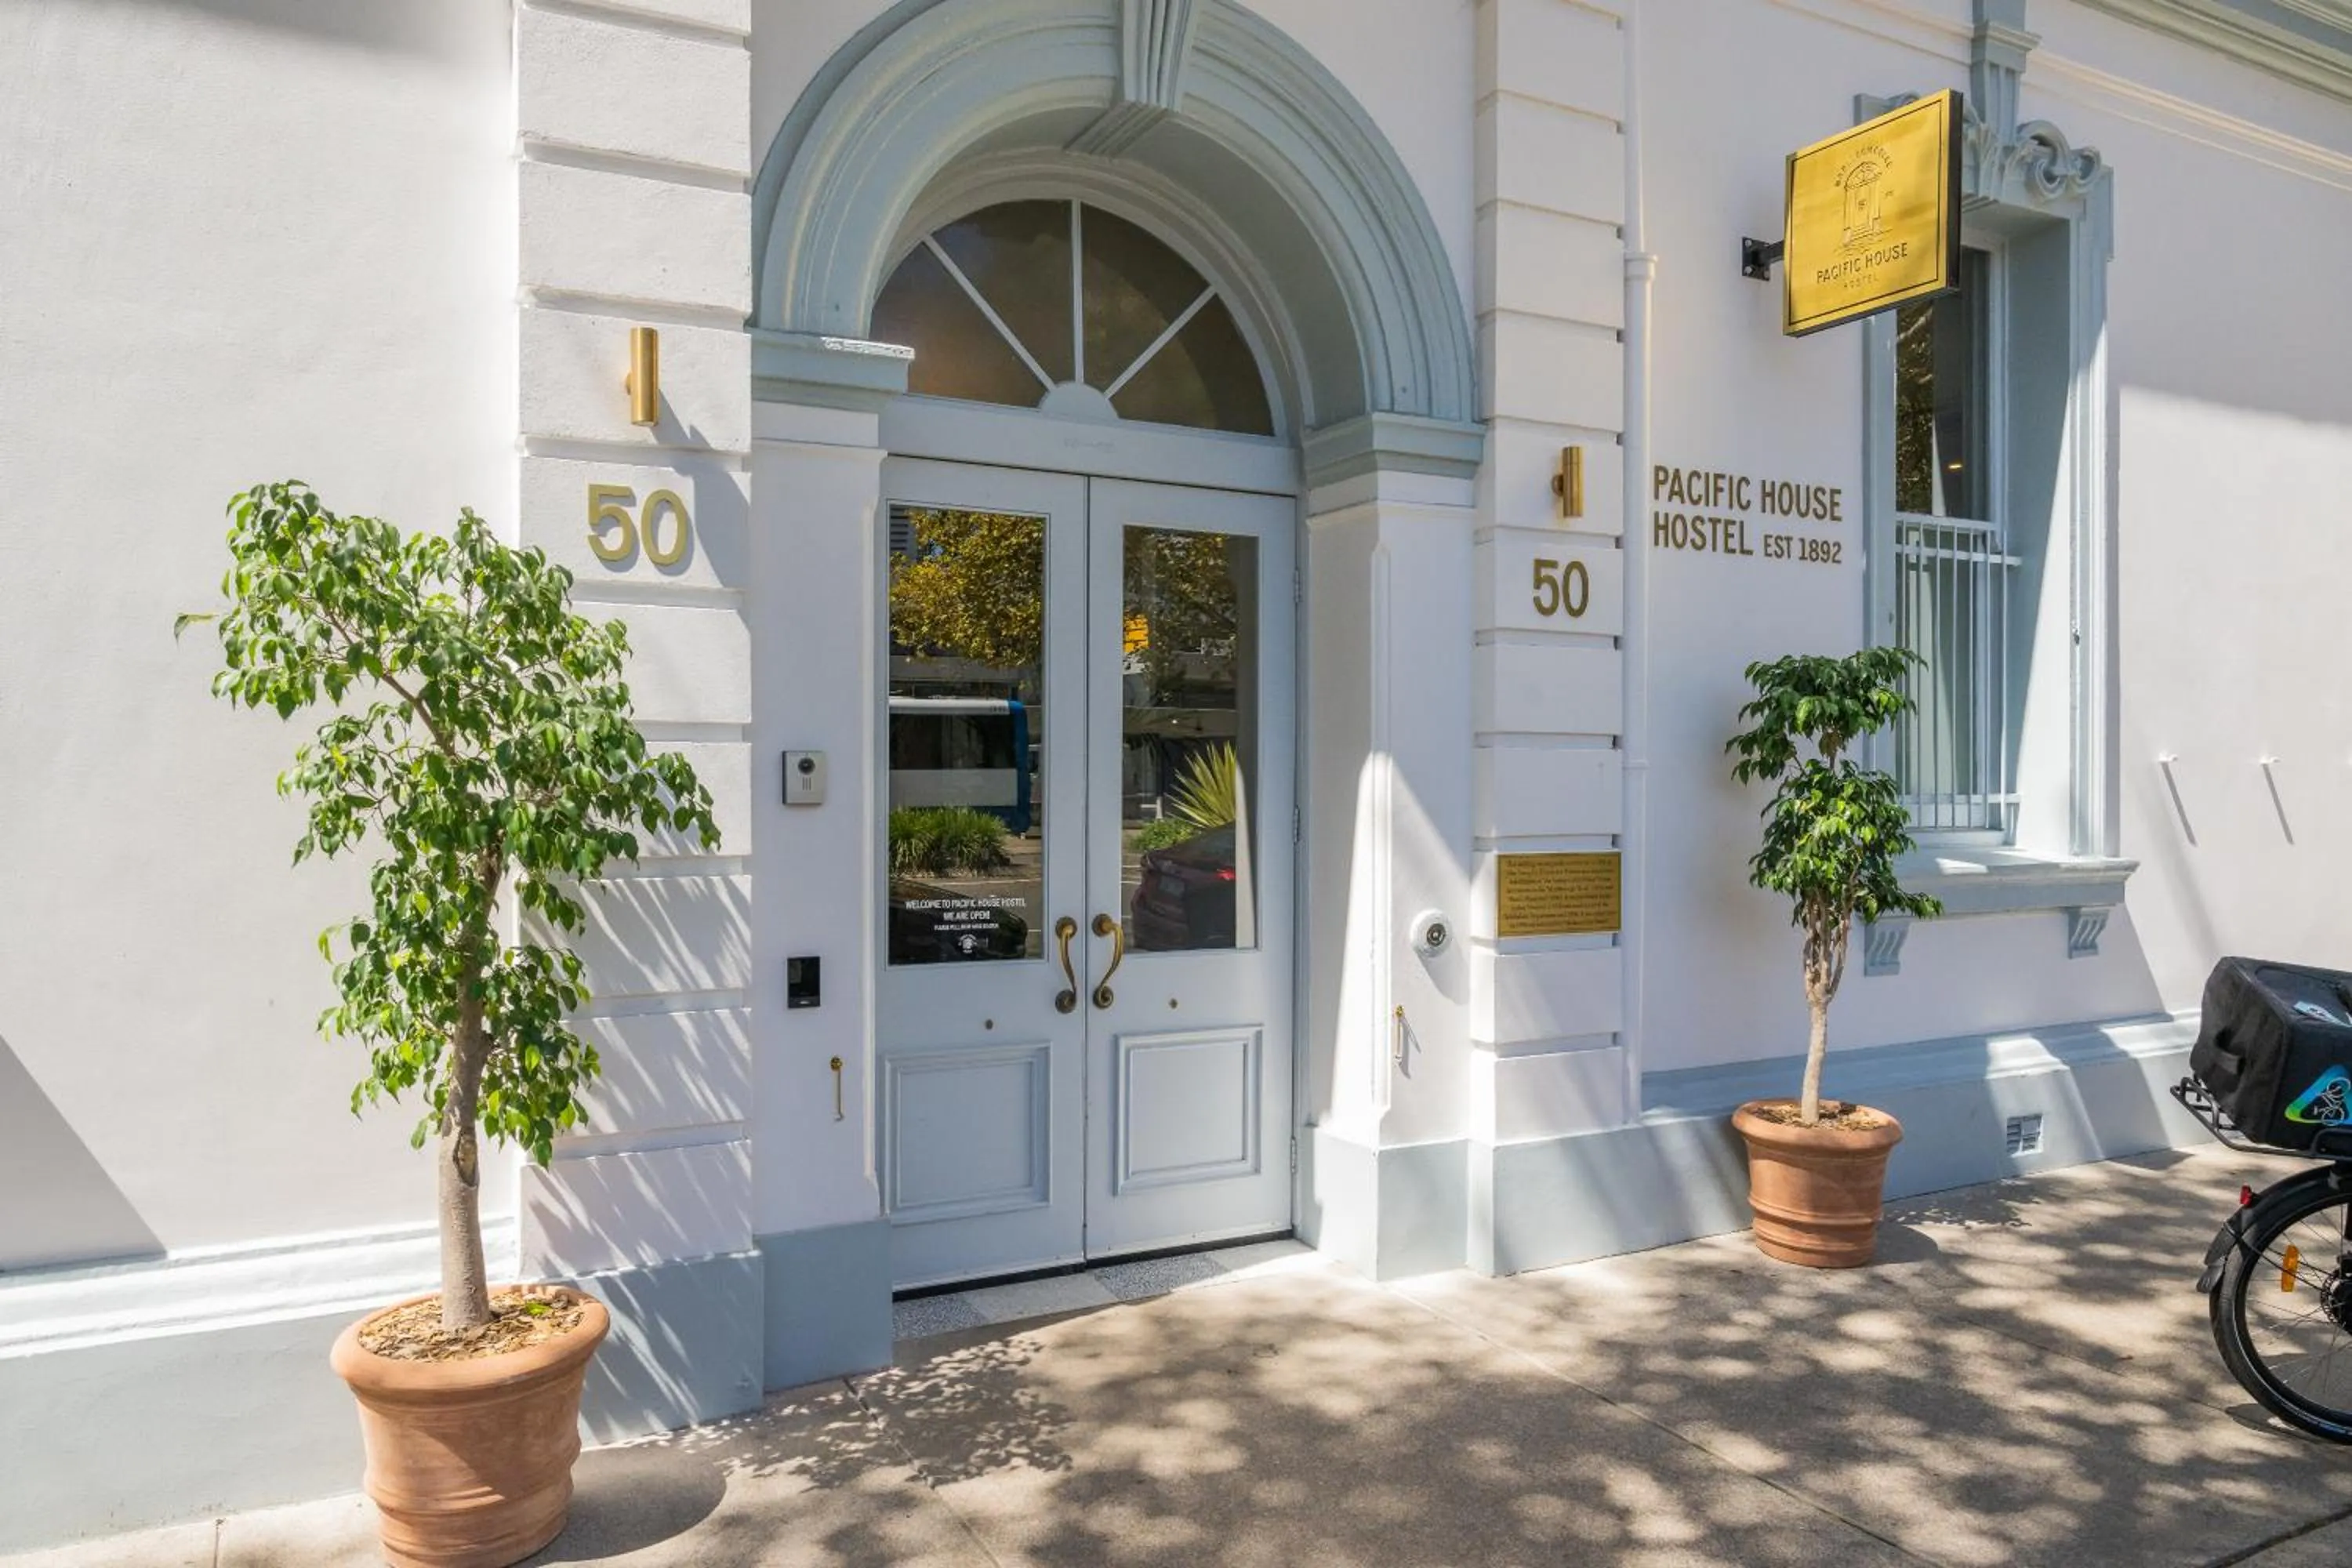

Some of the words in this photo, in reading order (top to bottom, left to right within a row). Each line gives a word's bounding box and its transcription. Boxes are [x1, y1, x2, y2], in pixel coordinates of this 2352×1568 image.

[1817, 257, 1861, 284] PACIFIC
[1865, 242, 1907, 268] HOUSE
[1653, 464, 1752, 511] PACIFIC
[1760, 478, 1842, 522] HOUSE
[587, 484, 688, 567] 50
[1653, 510, 1754, 556] HOSTEL
[1763, 533, 1794, 559] EST
[1798, 536, 1842, 564] 1892
[1533, 558, 1589, 619] 50
[905, 899, 941, 909] WELCOME
[942, 899, 950, 909] TO
[951, 898, 976, 909] PACIFIC
[978, 898, 1000, 907] HOUSE
